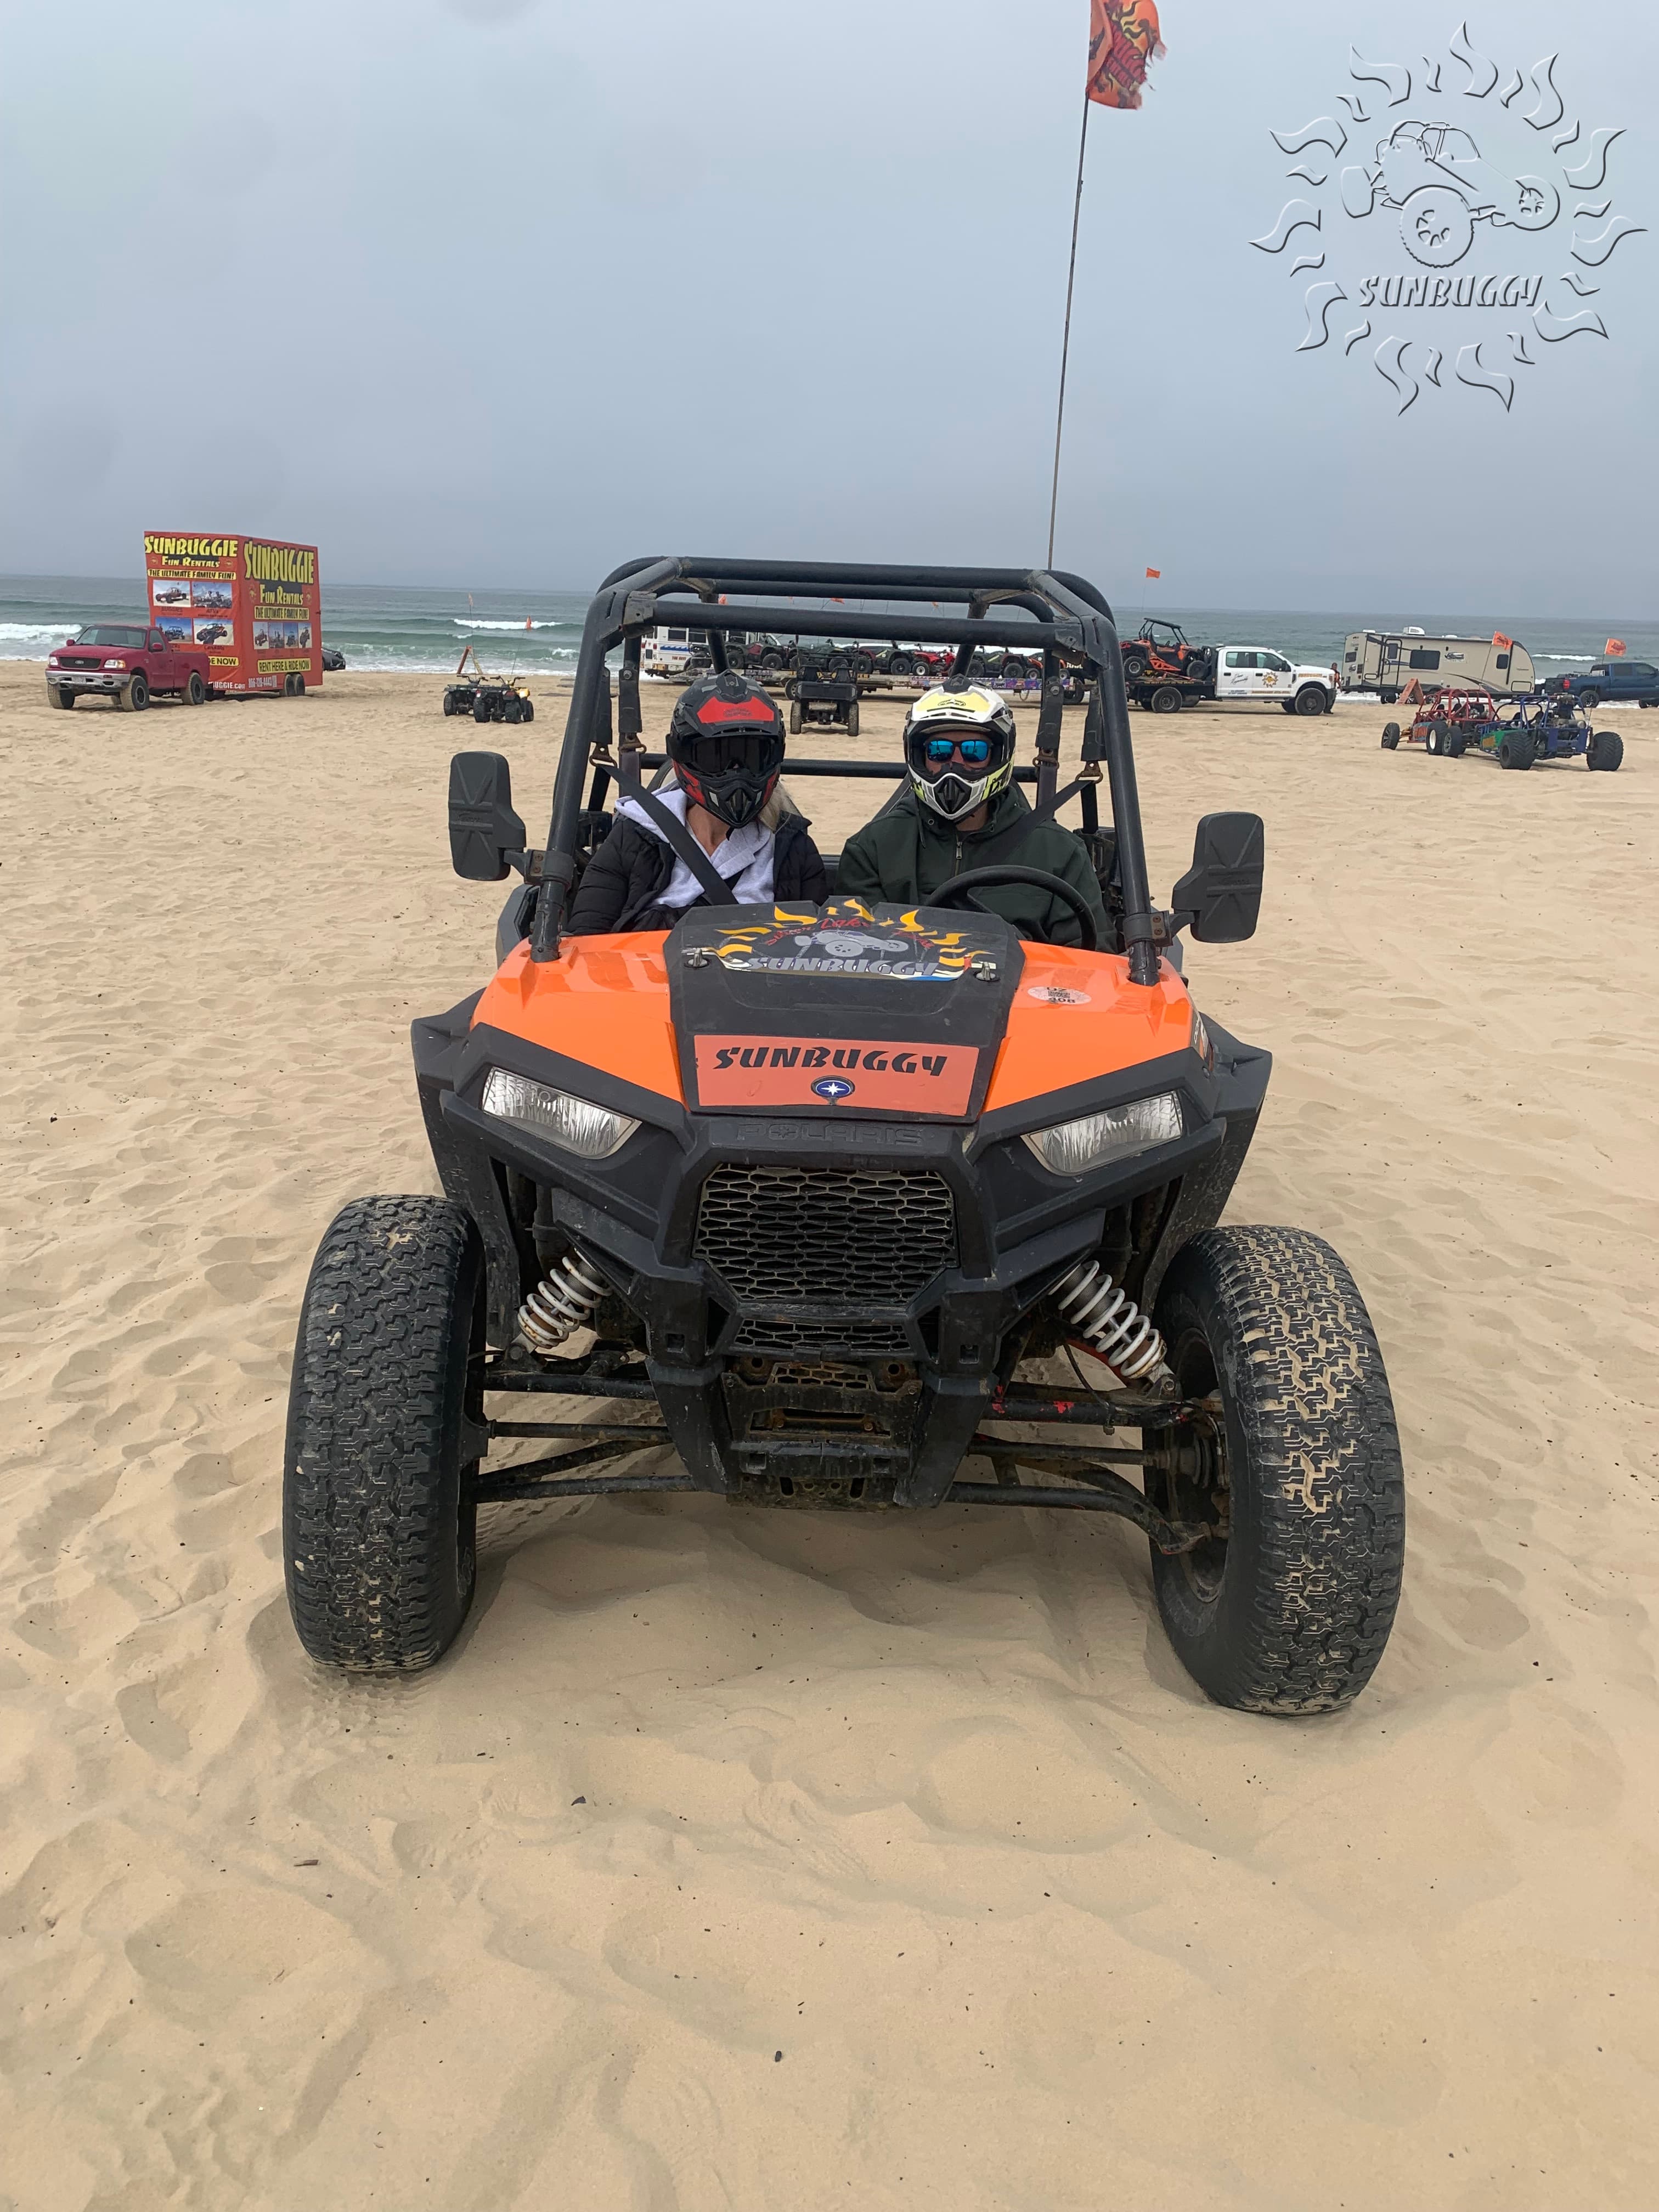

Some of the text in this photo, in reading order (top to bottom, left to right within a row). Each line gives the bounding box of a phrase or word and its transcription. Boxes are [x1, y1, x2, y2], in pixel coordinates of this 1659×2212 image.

[144, 535, 238, 557] SUNBUGGIE
[244, 540, 314, 583] SUNBUGGIE
[264, 608, 283, 619] ULTIMATE
[259, 659, 310, 672] RENT HERE & RIDE NOW
[748, 957, 939, 976] SUNBUGGY
[713, 1046, 948, 1076] SUNBUGGY
[737, 1124, 924, 1147] POLARIS
